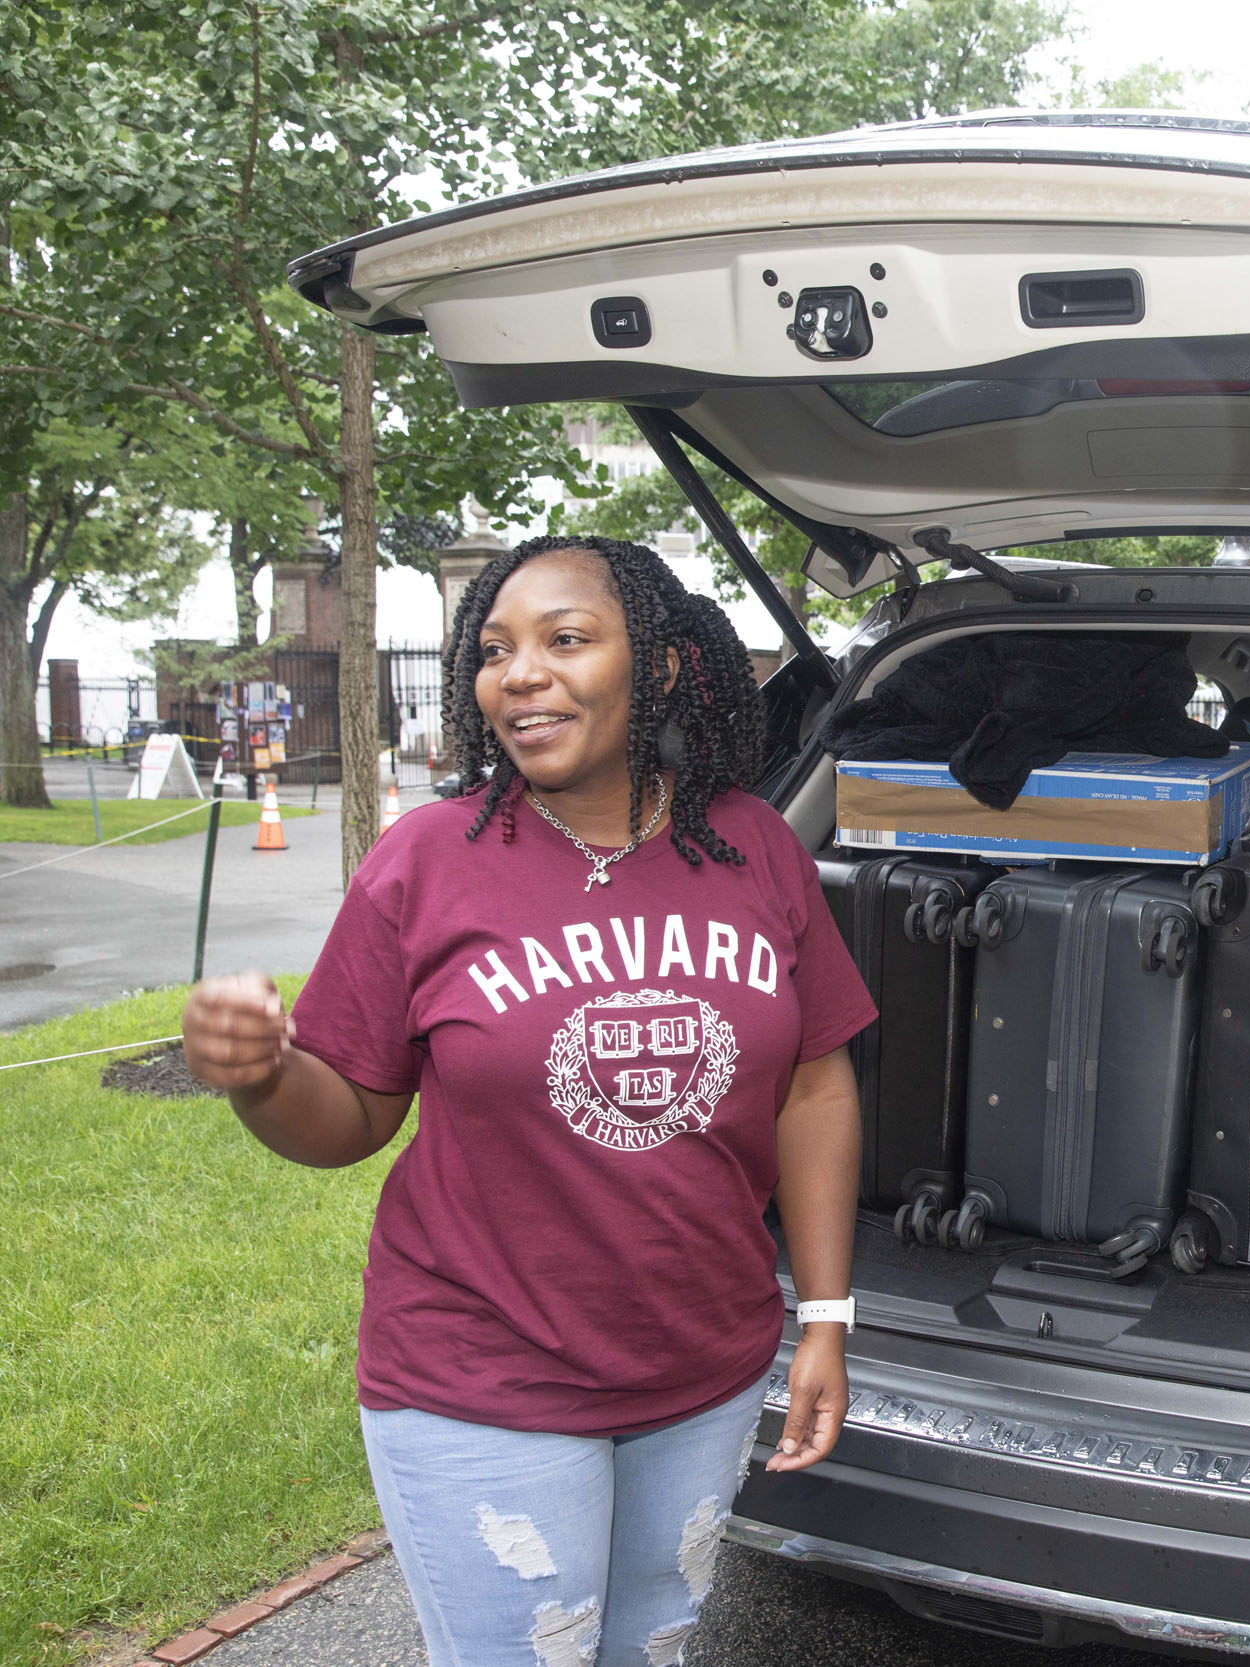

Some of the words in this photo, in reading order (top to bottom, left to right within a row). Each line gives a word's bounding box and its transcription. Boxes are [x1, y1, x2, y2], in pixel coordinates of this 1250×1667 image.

[468, 914, 777, 1014] HARVARD
[602, 1029, 629, 1046] VE
[660, 1024, 684, 1043] RI
[631, 1076, 661, 1095] TAS
[594, 1120, 688, 1148] HARVARD
